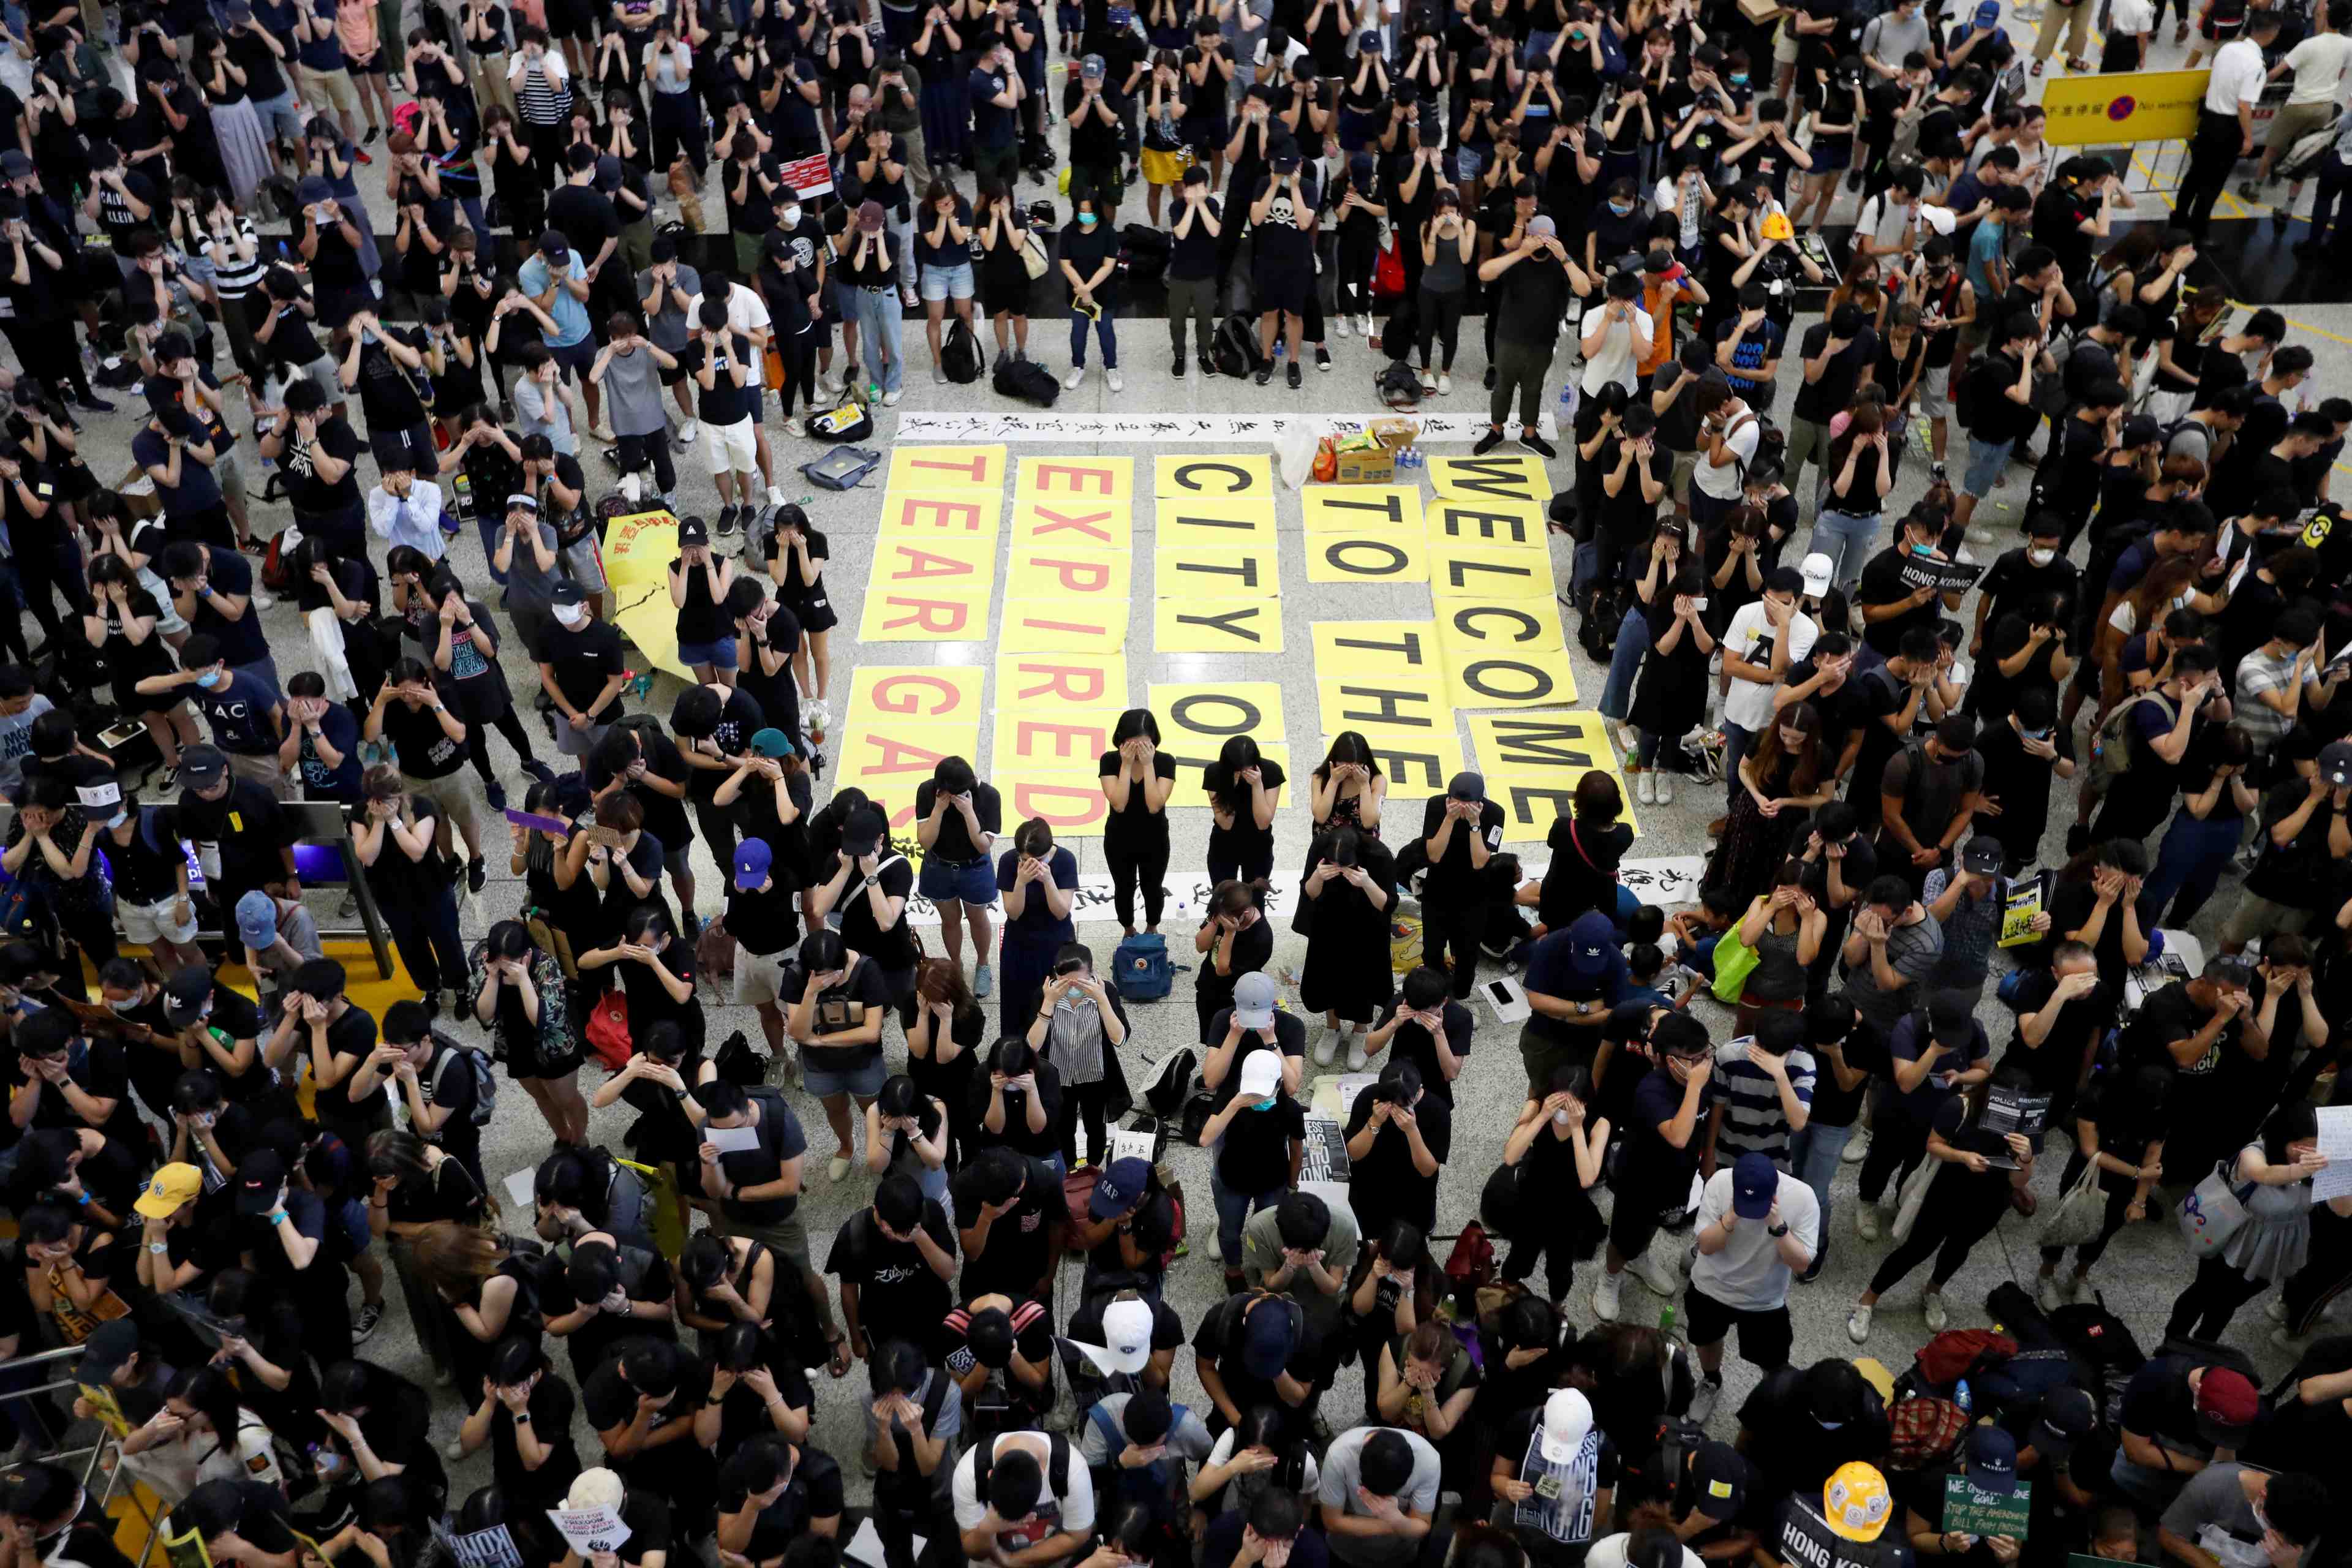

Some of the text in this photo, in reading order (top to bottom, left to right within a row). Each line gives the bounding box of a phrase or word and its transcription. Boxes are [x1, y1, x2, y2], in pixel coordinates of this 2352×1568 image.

[99, 190, 126, 205] CALV
[107, 211, 135, 224] KLEIN
[882, 456, 987, 633] TEAR
[1322, 495, 1409, 575] TO
[1901, 565, 1973, 590] HONG KONG
[1170, 463, 1262, 769] CITY O
[1014, 464, 1114, 827] EXPIRED
[1445, 458, 1594, 824] WELCOME
[1335, 633, 1444, 788] THE
[1989, 1095, 2017, 1107] POLICE
[1101, 1180, 1120, 1200] GAP
[1947, 1479, 1965, 1494] WE
[2013, 1489, 2030, 1500] ONE
[1943, 1502, 1968, 1515] STOP
[1782, 1522, 1831, 1568] HONG
